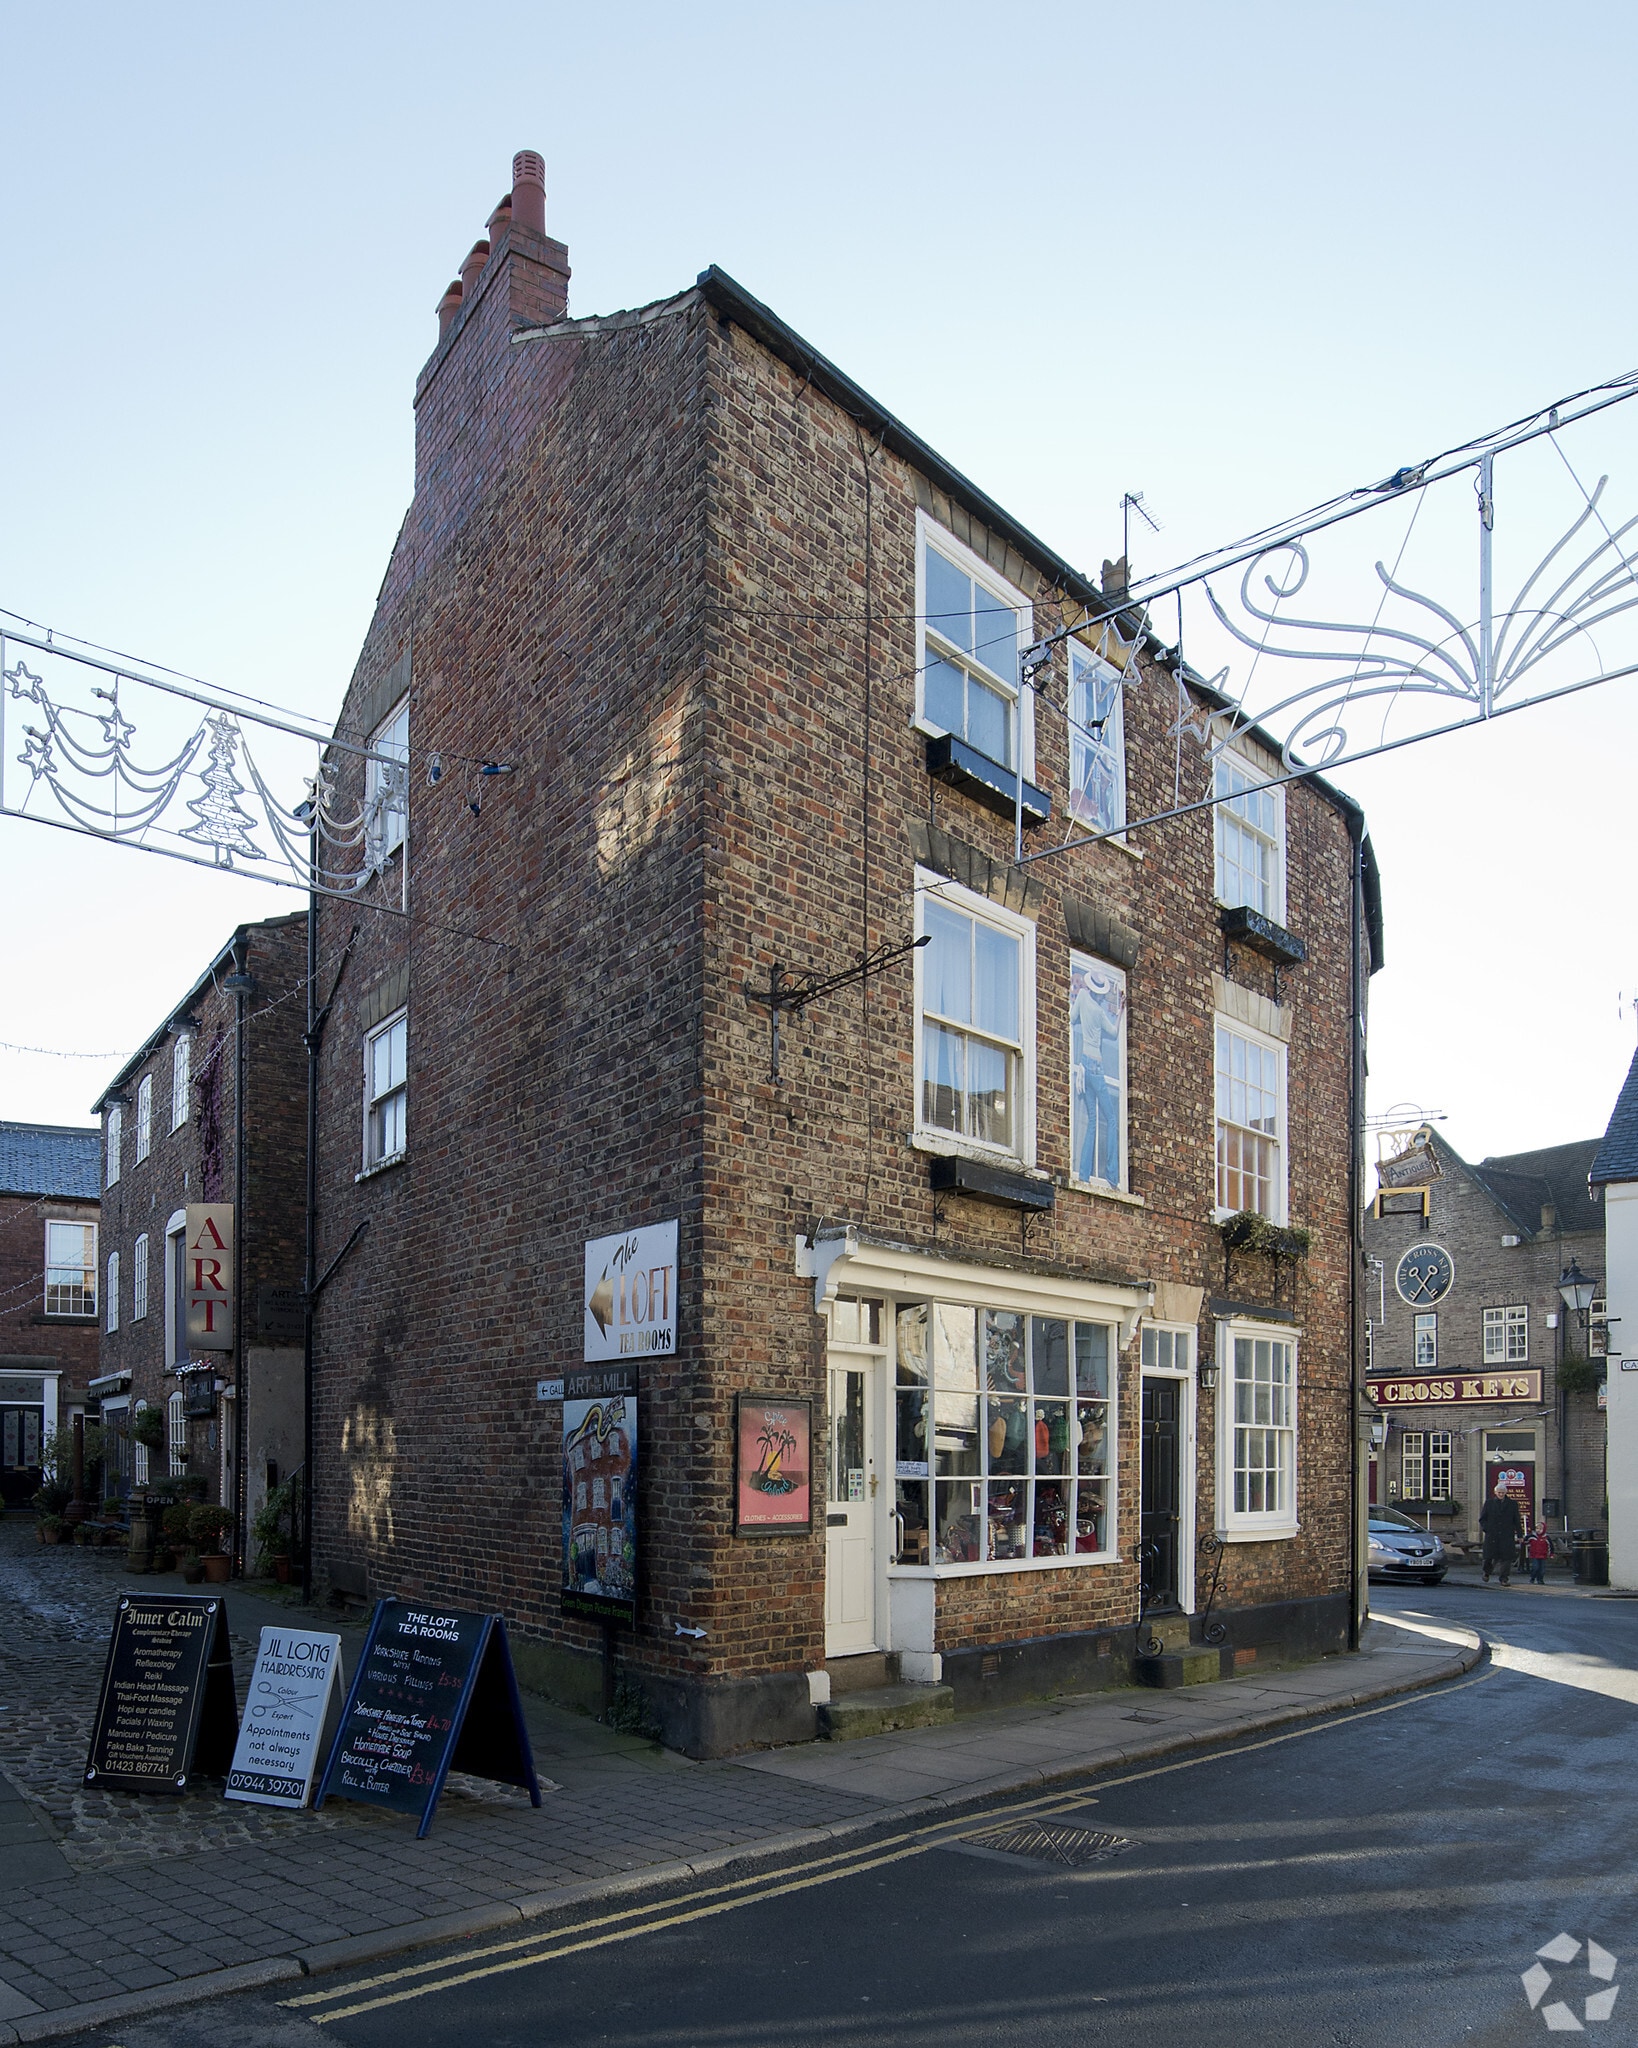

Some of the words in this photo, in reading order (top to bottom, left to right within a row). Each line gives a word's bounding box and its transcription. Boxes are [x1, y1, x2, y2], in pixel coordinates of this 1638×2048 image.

[612, 1236, 639, 1273] The
[1407, 1249, 1438, 1263] CROSS
[190, 1216, 229, 1333] ART
[620, 1265, 673, 1326] LOFT
[620, 1333, 635, 1353] TEA
[638, 1328, 671, 1352] ROOMS
[568, 1376, 591, 1394] ART
[603, 1373, 632, 1392] MILL
[1383, 1381, 1456, 1401] CROSS
[1462, 1377, 1529, 1398] KEYS
[764, 1411, 788, 1427] Spice
[1154, 1421, 1160, 1433] 2
[126, 1608, 164, 1626] Inner
[167, 1611, 204, 1627] Calm
[407, 1612, 428, 1625] THE
[429, 1615, 458, 1629] LOFT
[398, 1623, 418, 1635] TEA
[420, 1627, 460, 1642] ROOMS
[133, 1648, 183, 1659] Aromatherapy
[264, 1639, 282, 1657] JIL
[287, 1641, 330, 1663] LONG
[135, 1659, 176, 1670] Reflexology
[260, 1660, 325, 1680] HAIRDRESSING
[144, 1671, 163, 1680] Reiki
[367, 1670, 398, 1684] VARIOUS
[404, 1674, 434, 1691] FILLINGS
[114, 1681, 135, 1690] Indian
[137, 1682, 155, 1691] Head
[156, 1683, 189, 1693] Massage
[278, 1687, 298, 1696] Colour
[150, 1695, 183, 1706] Massage
[118, 1704, 134, 1714] Hopi
[149, 1707, 176, 1716] candles
[271, 1711, 293, 1721] Expert
[116, 1716, 141, 1726] Facials
[147, 1719, 174, 1729] Waxing
[108, 1729, 140, 1739] Manicure
[146, 1731, 178, 1741] Pedicure
[246, 1723, 310, 1741] Appointments
[107, 1741, 124, 1751] Fake
[126, 1743, 144, 1752] Bake
[146, 1744, 174, 1756] Tanning
[249, 1741, 265, 1750] not
[269, 1742, 300, 1758] always
[392, 1744, 412, 1759] SOUP
[105, 1760, 134, 1772] 01423
[135, 1762, 169, 1774] 867741
[248, 1756, 295, 1773] necessary
[230, 1774, 265, 1791] 07944
[267, 1779, 304, 1796] 397301
